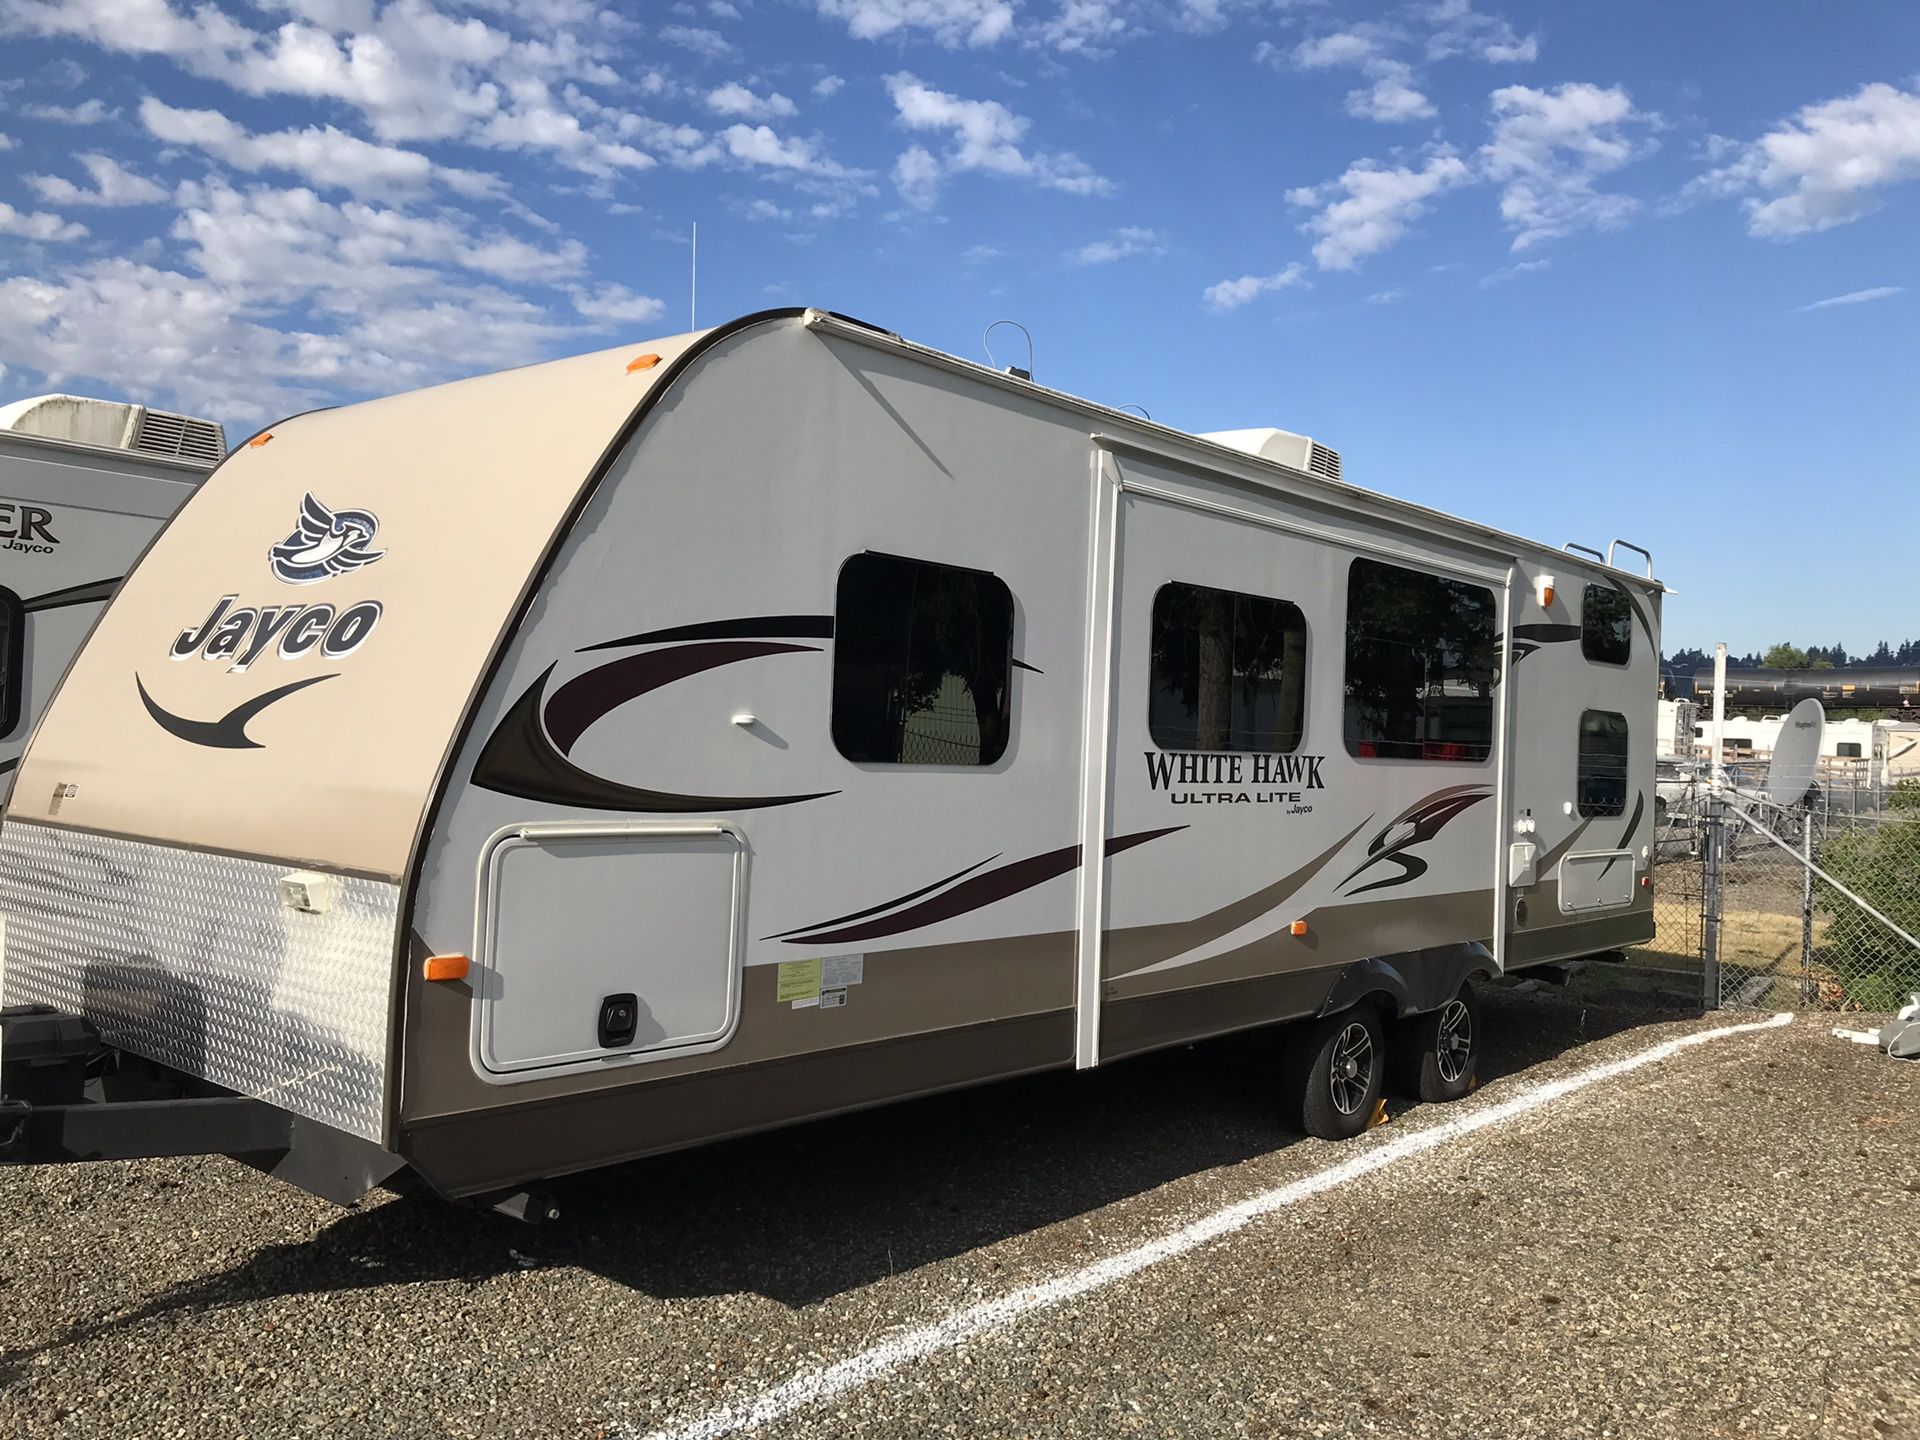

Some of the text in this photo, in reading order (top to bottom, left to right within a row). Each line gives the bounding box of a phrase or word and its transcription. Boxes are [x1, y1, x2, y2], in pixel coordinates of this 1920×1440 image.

[2, 539, 54, 554] Jayco
[169, 594, 384, 673] Jayco
[1144, 752, 1325, 790] WHITE HAWK
[1171, 792, 1301, 804] ULTRA LITE
[1291, 804, 1313, 815] Jayco
